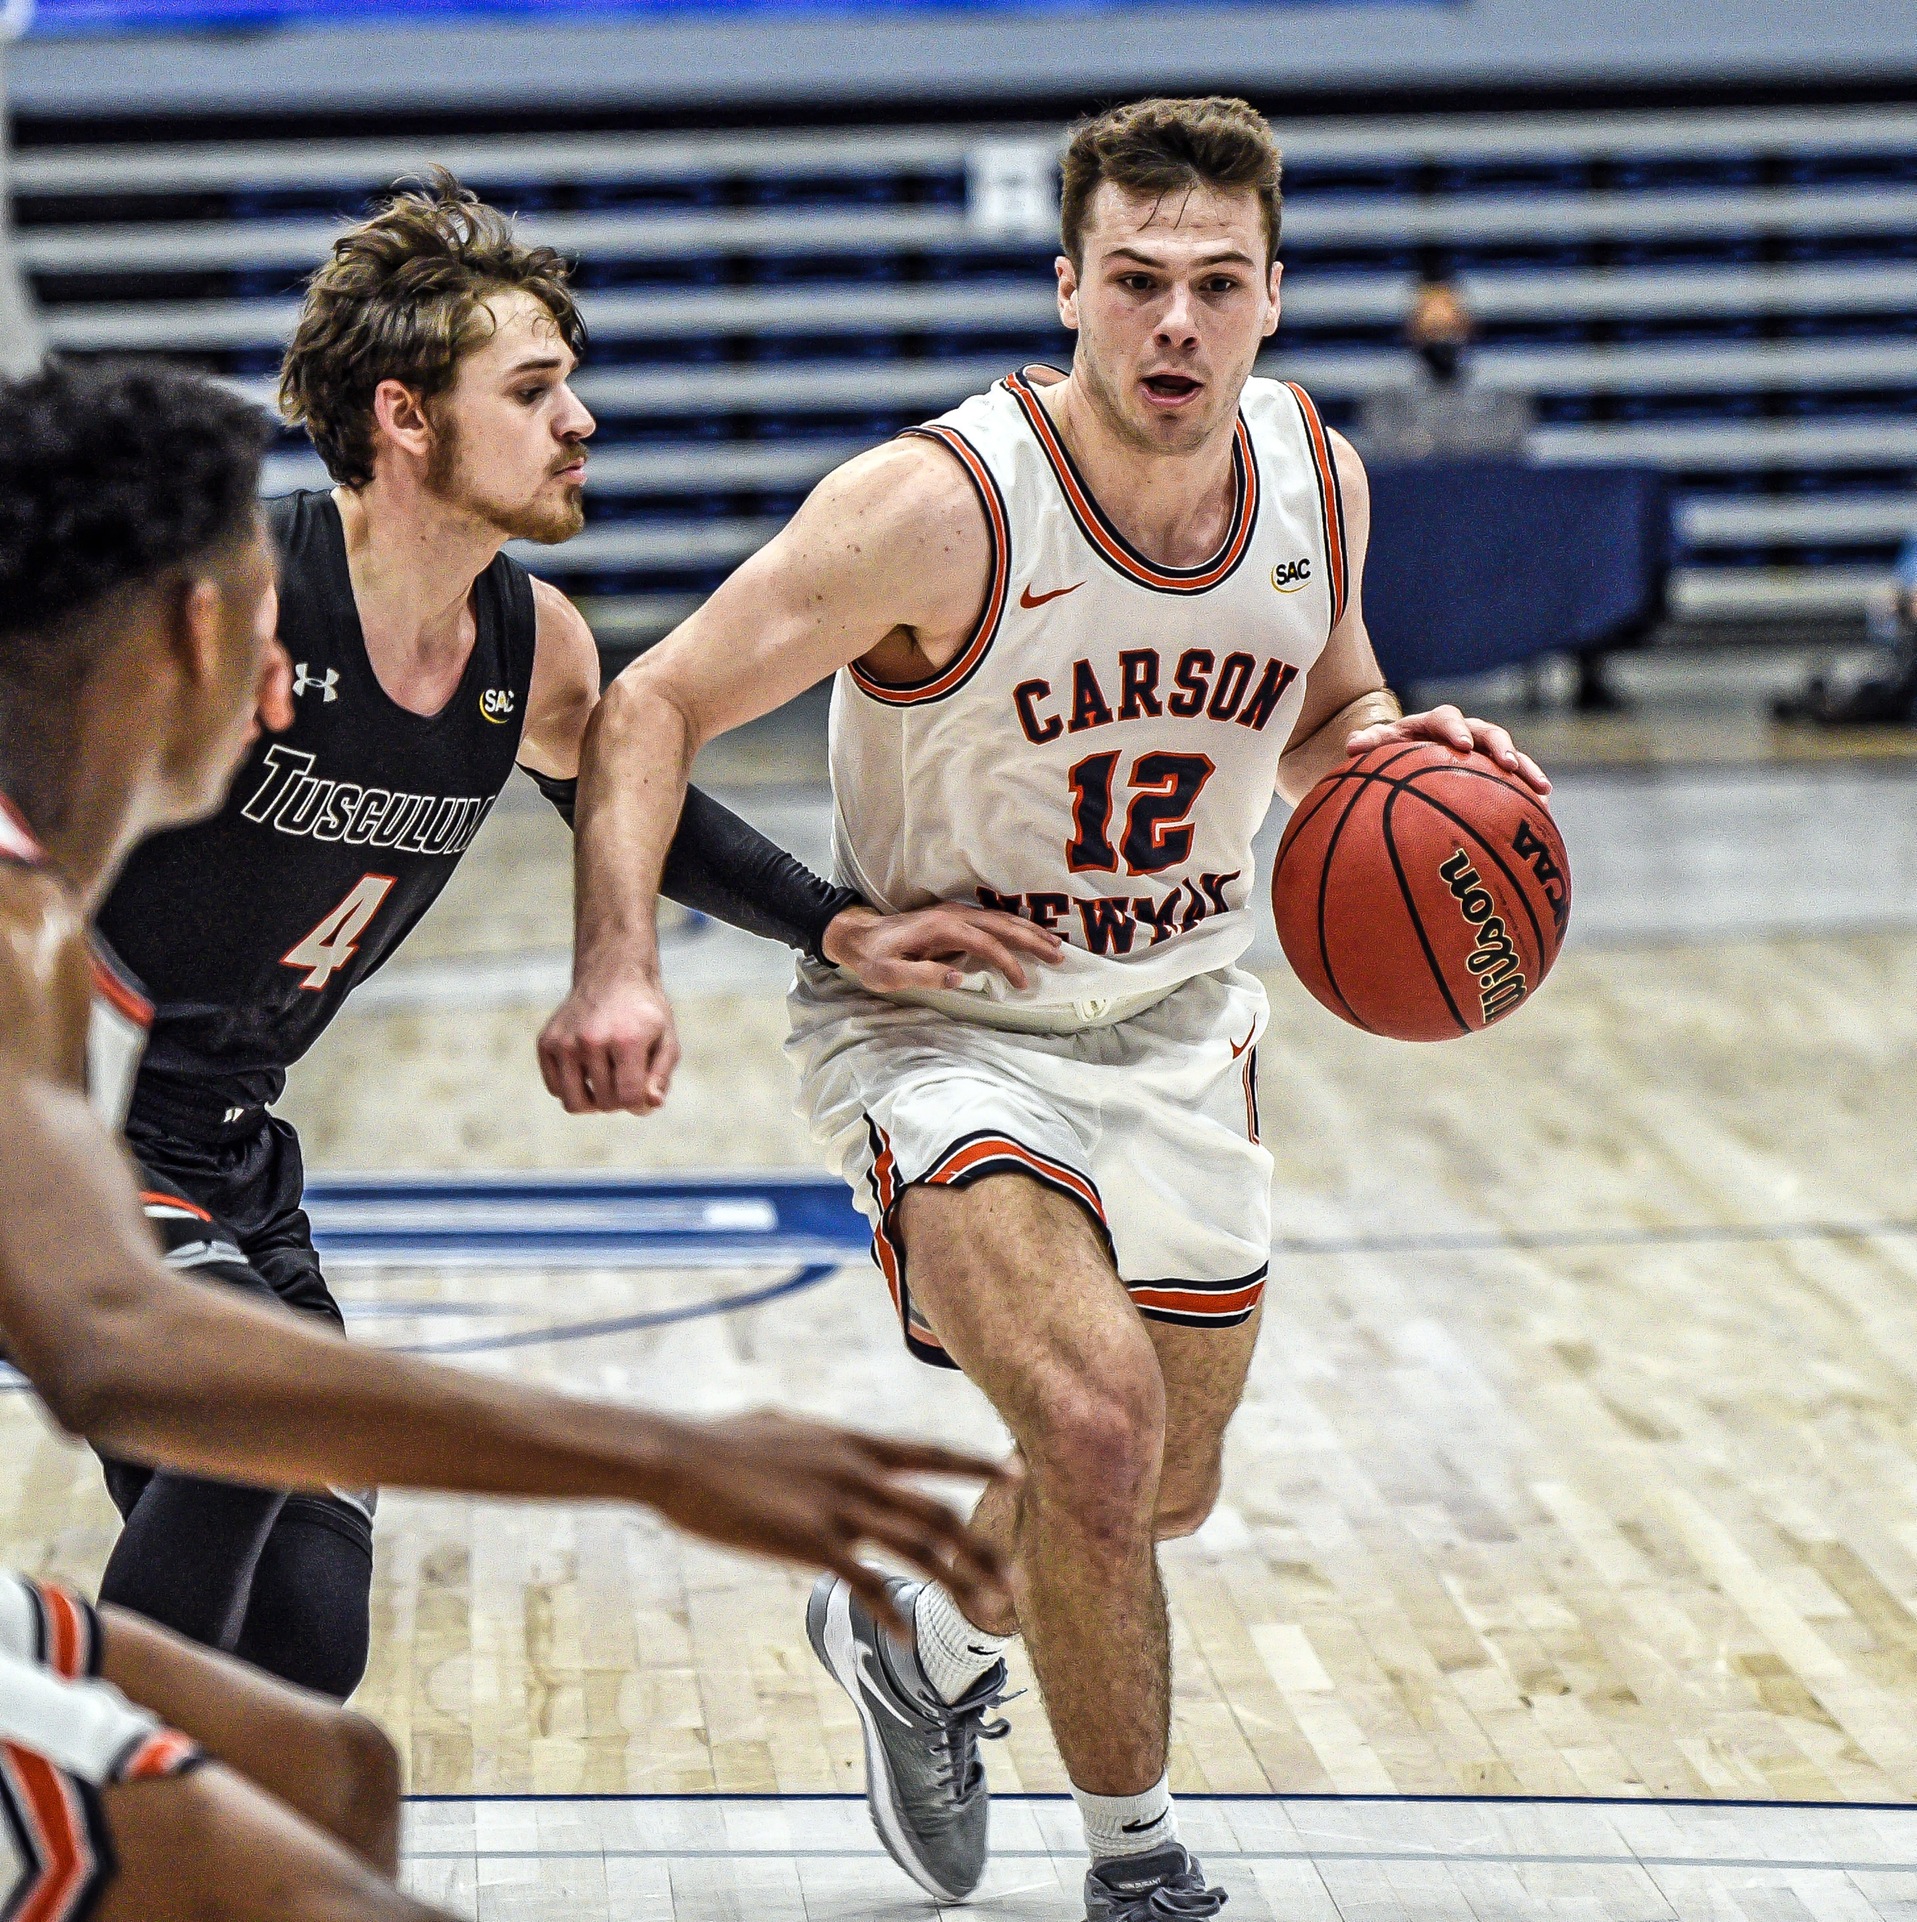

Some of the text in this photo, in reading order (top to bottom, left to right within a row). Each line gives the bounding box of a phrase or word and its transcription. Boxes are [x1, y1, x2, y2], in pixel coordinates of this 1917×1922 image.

[1274, 558, 1312, 586] SAC
[484, 688, 515, 713] SAC
[1012, 647, 1300, 746] CARSON
[241, 744, 497, 855] TUSCULUM
[1065, 749, 1217, 877] 12
[278, 872, 398, 991] 4
[1438, 847, 1528, 1025] Wilson
